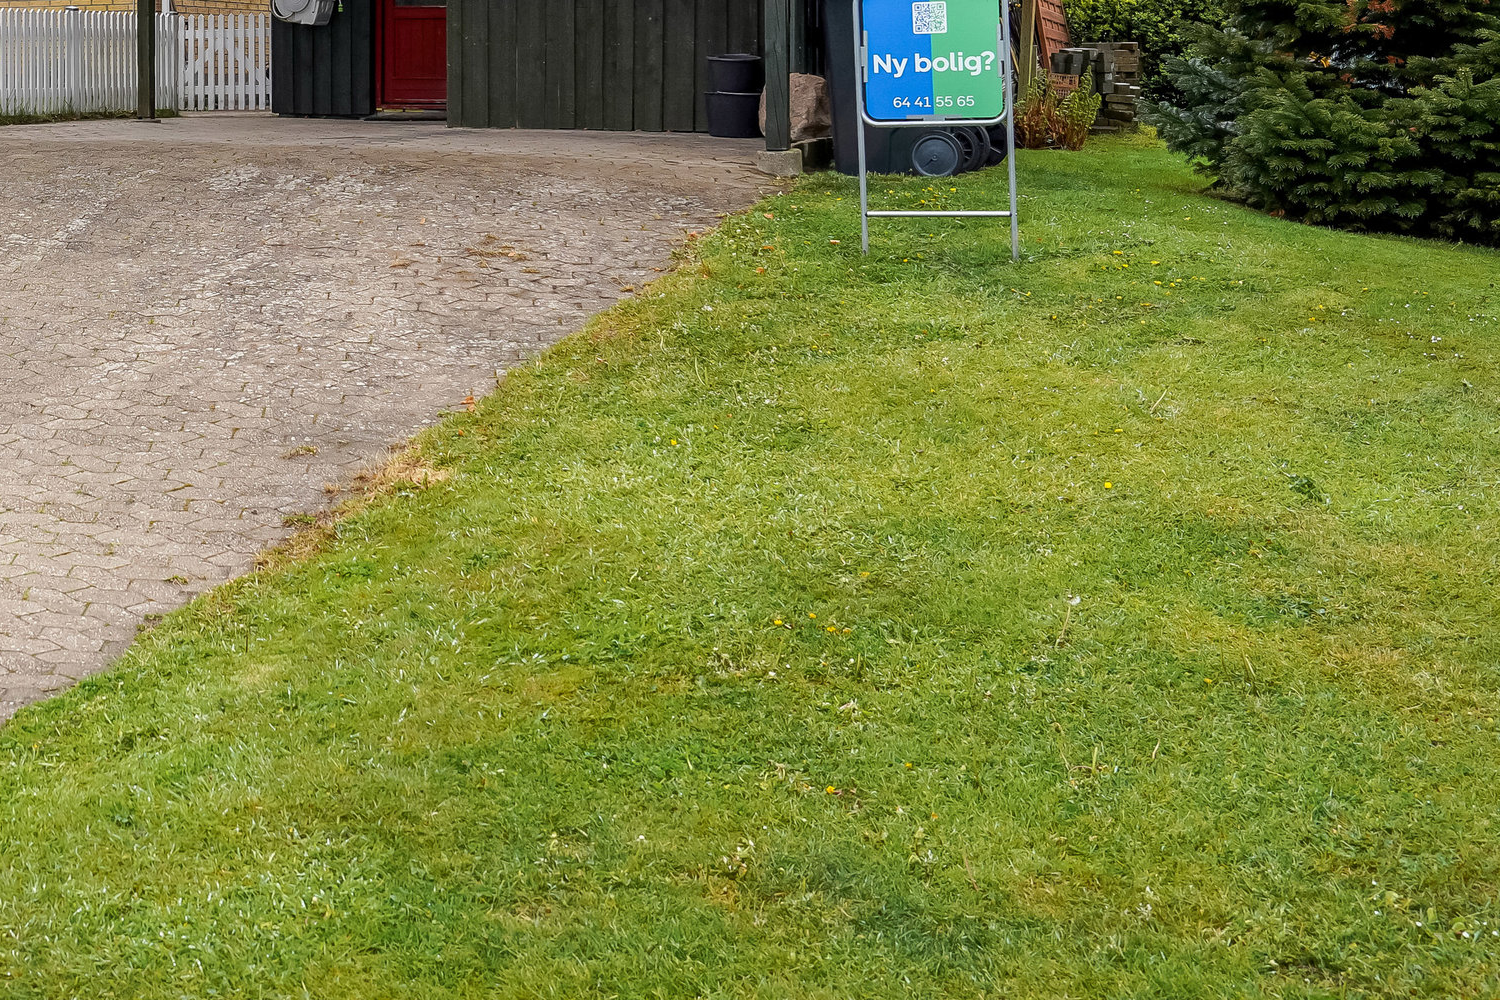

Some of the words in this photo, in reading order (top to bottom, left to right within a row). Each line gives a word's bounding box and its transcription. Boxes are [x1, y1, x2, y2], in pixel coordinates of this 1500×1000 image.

[873, 54, 908, 78] Ny
[914, 50, 996, 76] bolig?
[893, 96, 911, 108] 64
[914, 96, 932, 108] 41
[935, 95, 953, 107] 55
[956, 95, 975, 107] 65
